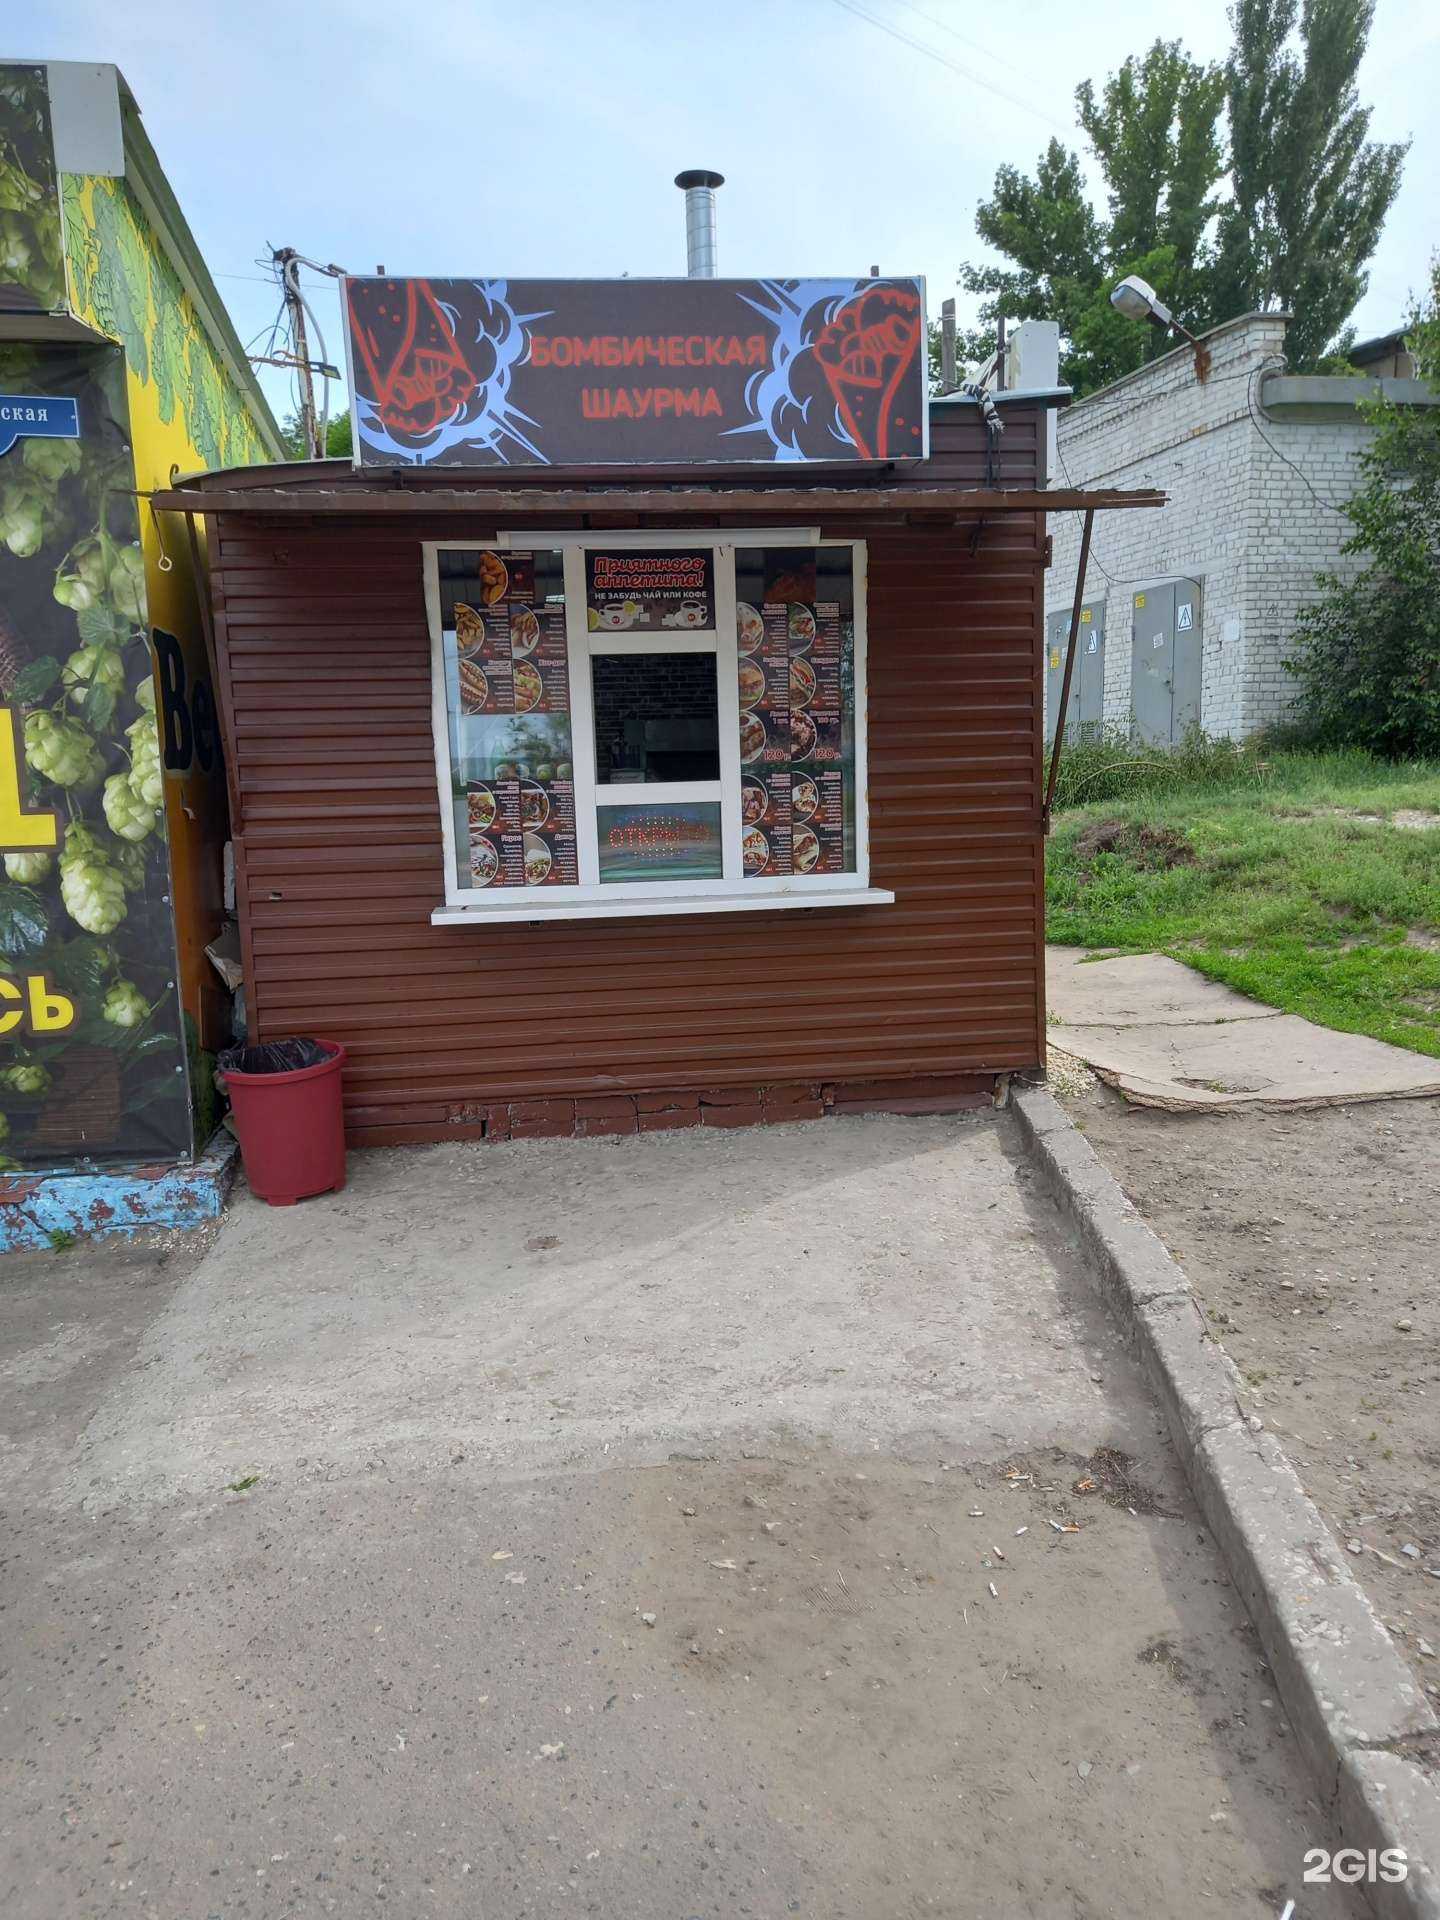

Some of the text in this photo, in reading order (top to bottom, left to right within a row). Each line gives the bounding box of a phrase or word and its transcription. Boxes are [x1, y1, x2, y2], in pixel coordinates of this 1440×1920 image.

[530, 335, 767, 368] БОМБИЧЕСКАЯ
[581, 386, 723, 419] ШАУРМА
[0, 406, 49, 422] ская
[594, 557, 705, 575] Приятного
[594, 571, 704, 588] аппетита!
[594, 590, 708, 600] НЕ ЗАБУДЬ ЧАЙ ИЛИ КОФЕ
